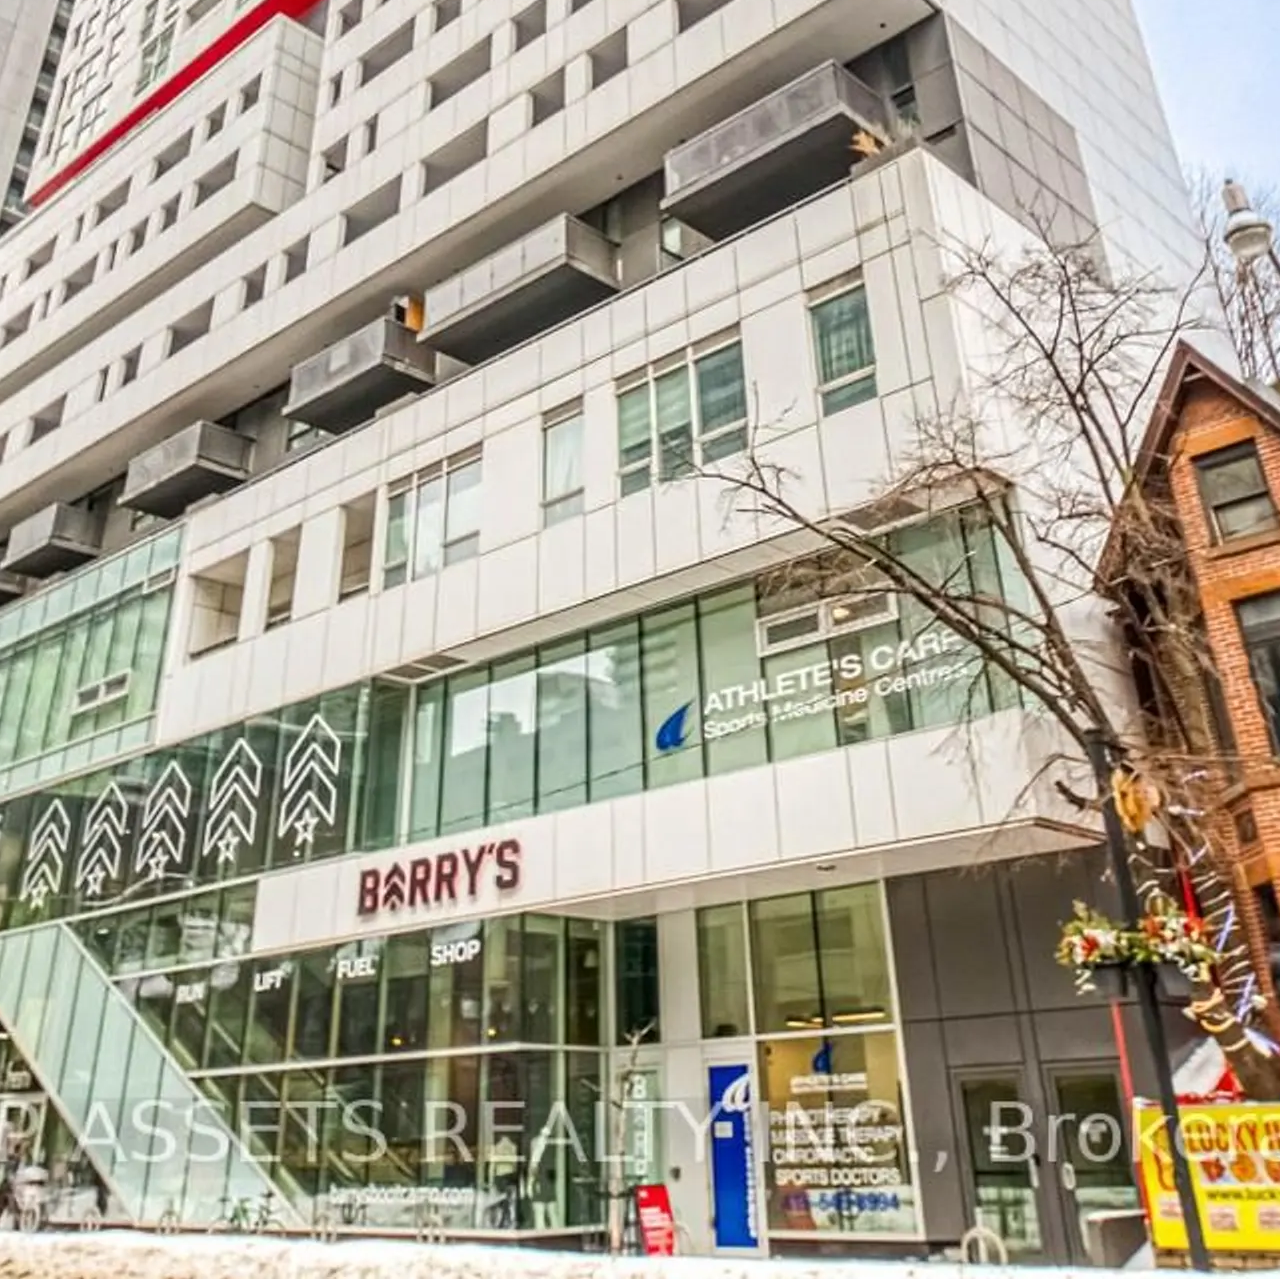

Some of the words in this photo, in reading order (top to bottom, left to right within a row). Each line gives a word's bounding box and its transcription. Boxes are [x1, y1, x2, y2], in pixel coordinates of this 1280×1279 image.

[704, 653, 862, 715] ATHLETE'S
[704, 710, 768, 739] Sports
[772, 686, 868, 723] Medicine
[357, 838, 520, 916] BARRY'S
[337, 955, 380, 979] FUEL
[430, 939, 481, 967] SHOP
[253, 969, 285, 993] LIFT
[1184, 1121, 1260, 1152] LUCKY
[830, 1167, 902, 1186] DOCTORS
